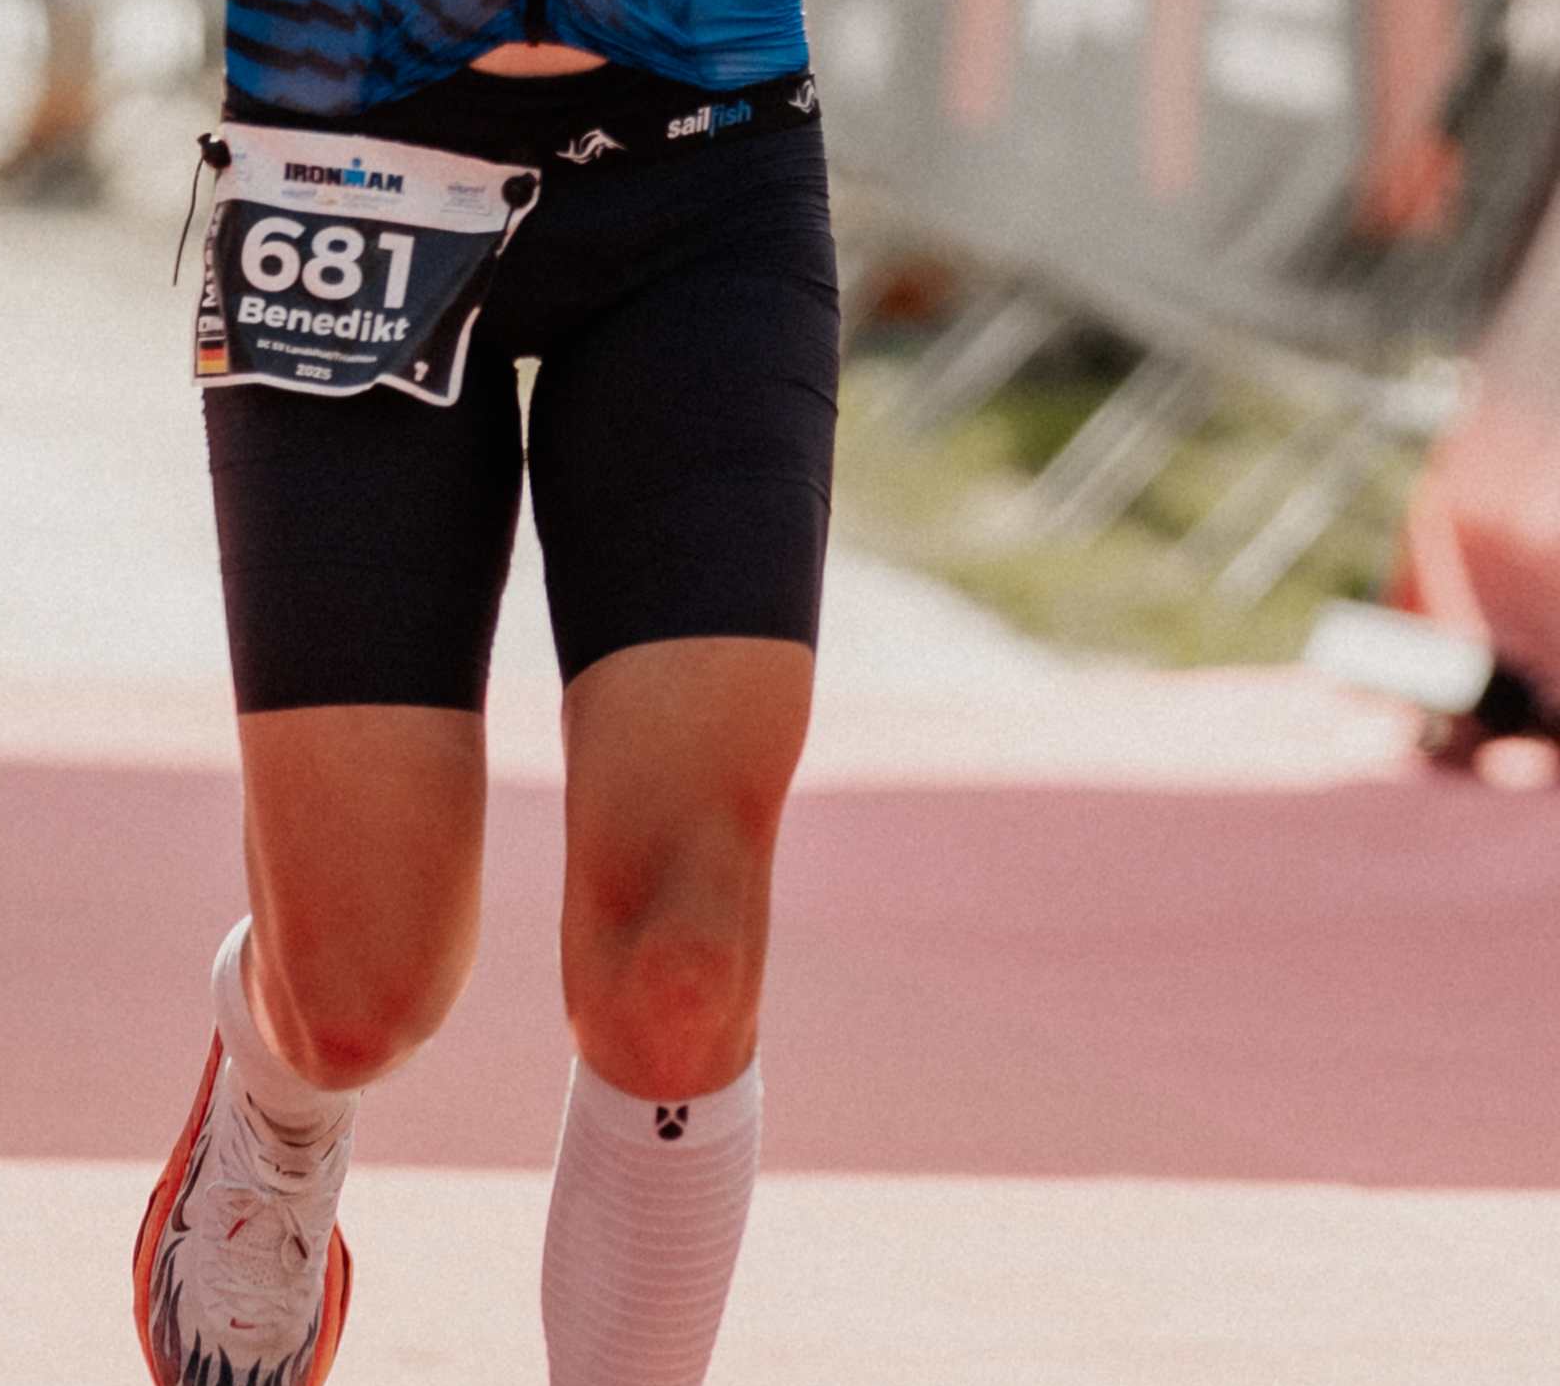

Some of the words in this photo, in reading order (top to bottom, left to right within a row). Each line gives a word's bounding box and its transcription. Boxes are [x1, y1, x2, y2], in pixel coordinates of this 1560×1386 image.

[666, 98, 753, 140] sailfish
[283, 158, 405, 194] IRONMAN
[241, 216, 416, 309] 681
[237, 295, 411, 343] Benedikt
